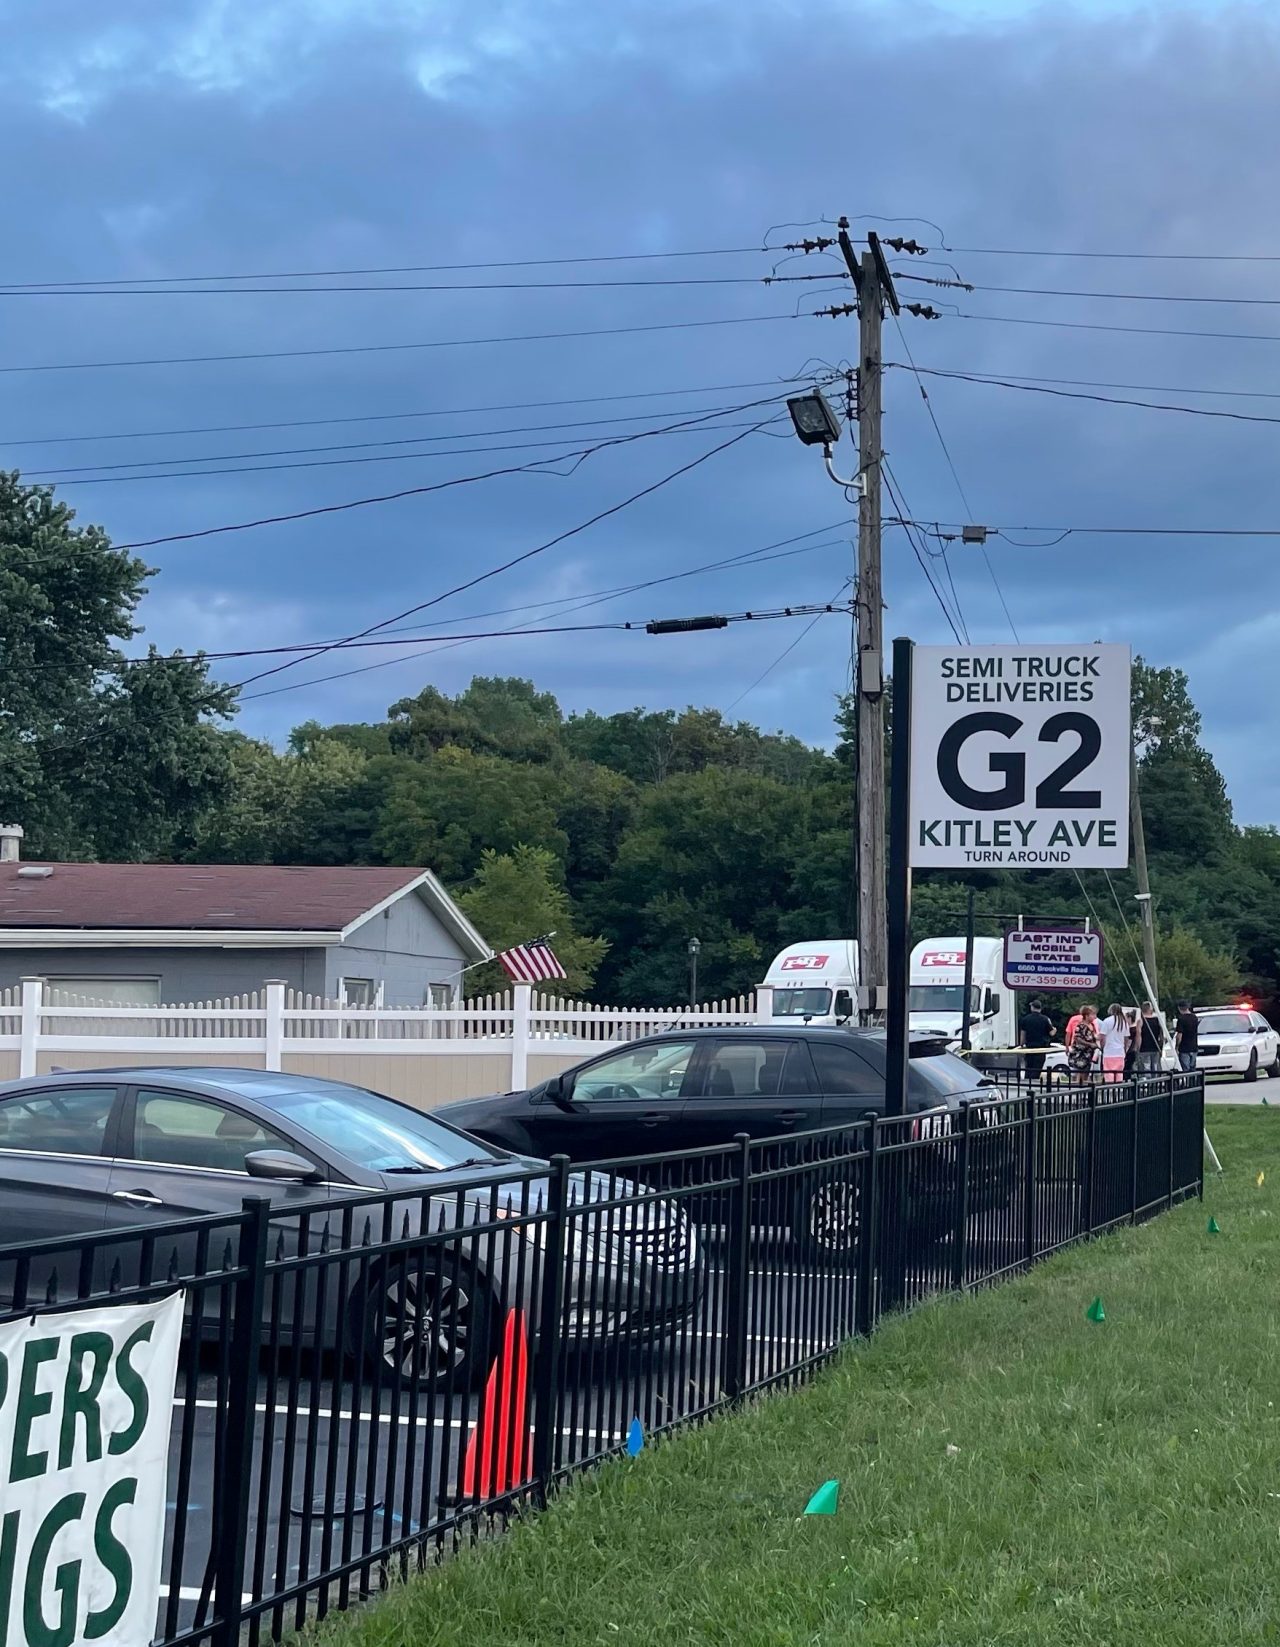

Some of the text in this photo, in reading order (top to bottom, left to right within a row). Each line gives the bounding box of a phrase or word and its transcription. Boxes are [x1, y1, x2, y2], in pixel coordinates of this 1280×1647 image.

[940, 656, 1101, 679] SEMI TRUCK
[946, 681, 1094, 703] DELIVERIES
[936, 711, 1102, 811] G2
[919, 819, 1118, 847] KITLEY AVE
[964, 851, 1071, 863] TURN AROUND
[1012, 934, 1095, 945] EAST INDY
[1030, 944, 1077, 953] MOBILE
[1025, 953, 1081, 962] ESTATES
[1037, 965, 1069, 973] Brookville
[1071, 966, 1088, 974] Road
[1013, 975, 1092, 986] 317-359-6660
[0, 1320, 155, 1483] ERS
